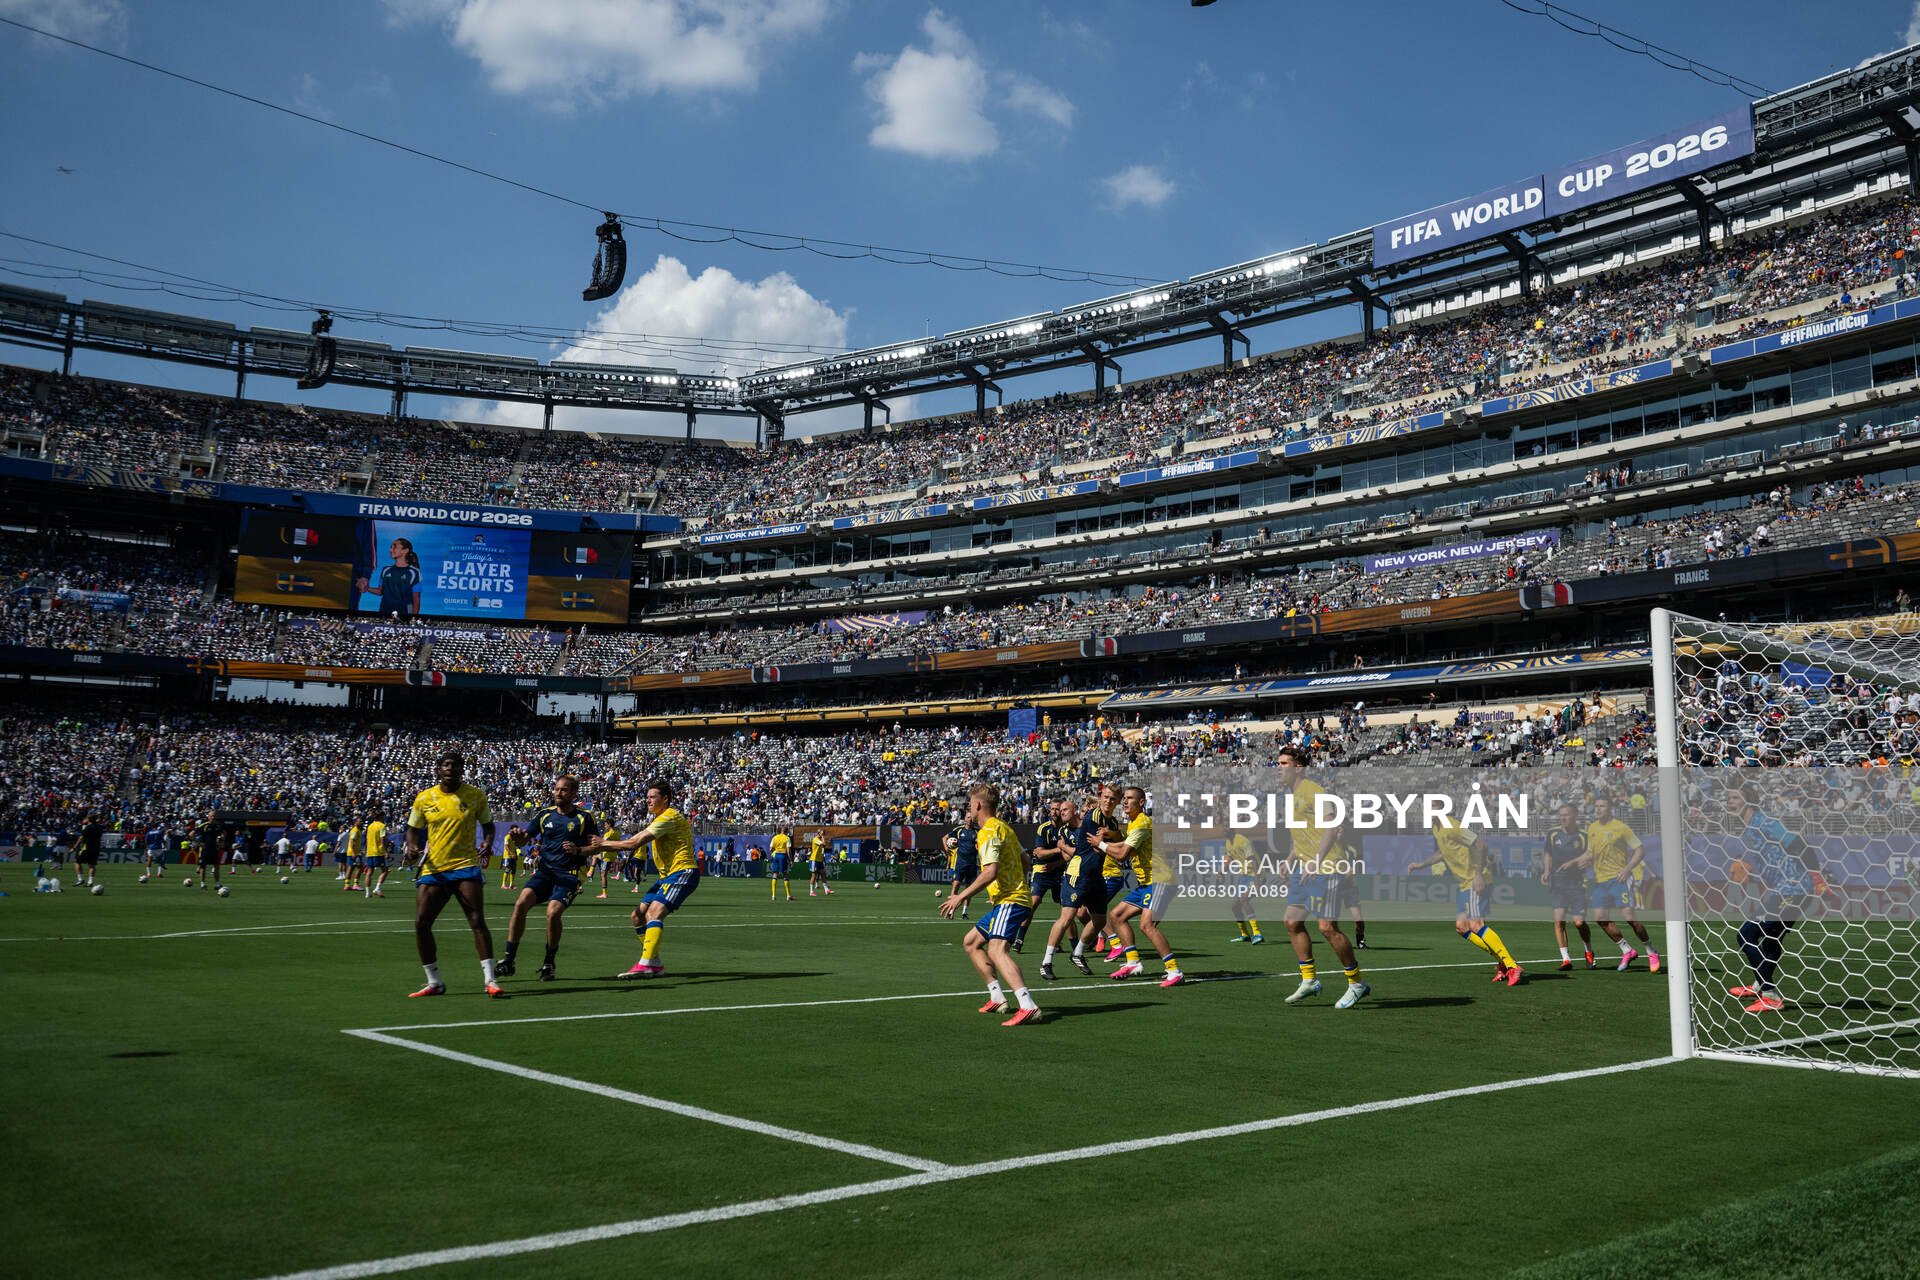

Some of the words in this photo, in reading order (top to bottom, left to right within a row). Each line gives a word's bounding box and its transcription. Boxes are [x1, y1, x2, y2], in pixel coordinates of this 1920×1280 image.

[1390, 218, 1442, 249] FIFA
[1451, 187, 1543, 231] WORLD
[1558, 164, 1613, 198] CUP
[1625, 125, 1728, 178] 2026
[1780, 313, 1869, 346] #FIFAWorldCup
[1162, 461, 1214, 477] #FIFAWorldCup
[359, 503, 392, 516] FIFA
[394, 505, 448, 520] WORLD
[450, 509, 480, 522] CUP
[481, 512, 533, 526] 2026
[704, 534, 723, 543] NEW
[724, 532, 746, 541] YORK
[748, 529, 767, 538] NEW
[768, 525, 802, 535] JERSEY
[461, 552, 494, 563] Today's
[1375, 556, 1406, 569] NEW
[1408, 549, 1447, 563] YORK
[1449, 544, 1484, 558] NEW
[442, 560, 511, 578] PLAYER
[1674, 568, 1710, 585] FRANCE
[437, 575, 514, 593] ESCORTS
[1400, 606, 1432, 620] SWEDEN
[1183, 631, 1206, 643] FRANCE
[73, 654, 104, 664] FRANCE
[832, 665, 852, 674] FRANCE
[515, 678, 539, 687] FRANCE
[1143, 893, 1151, 905] 2
[1310, 895, 1323, 913] 17
